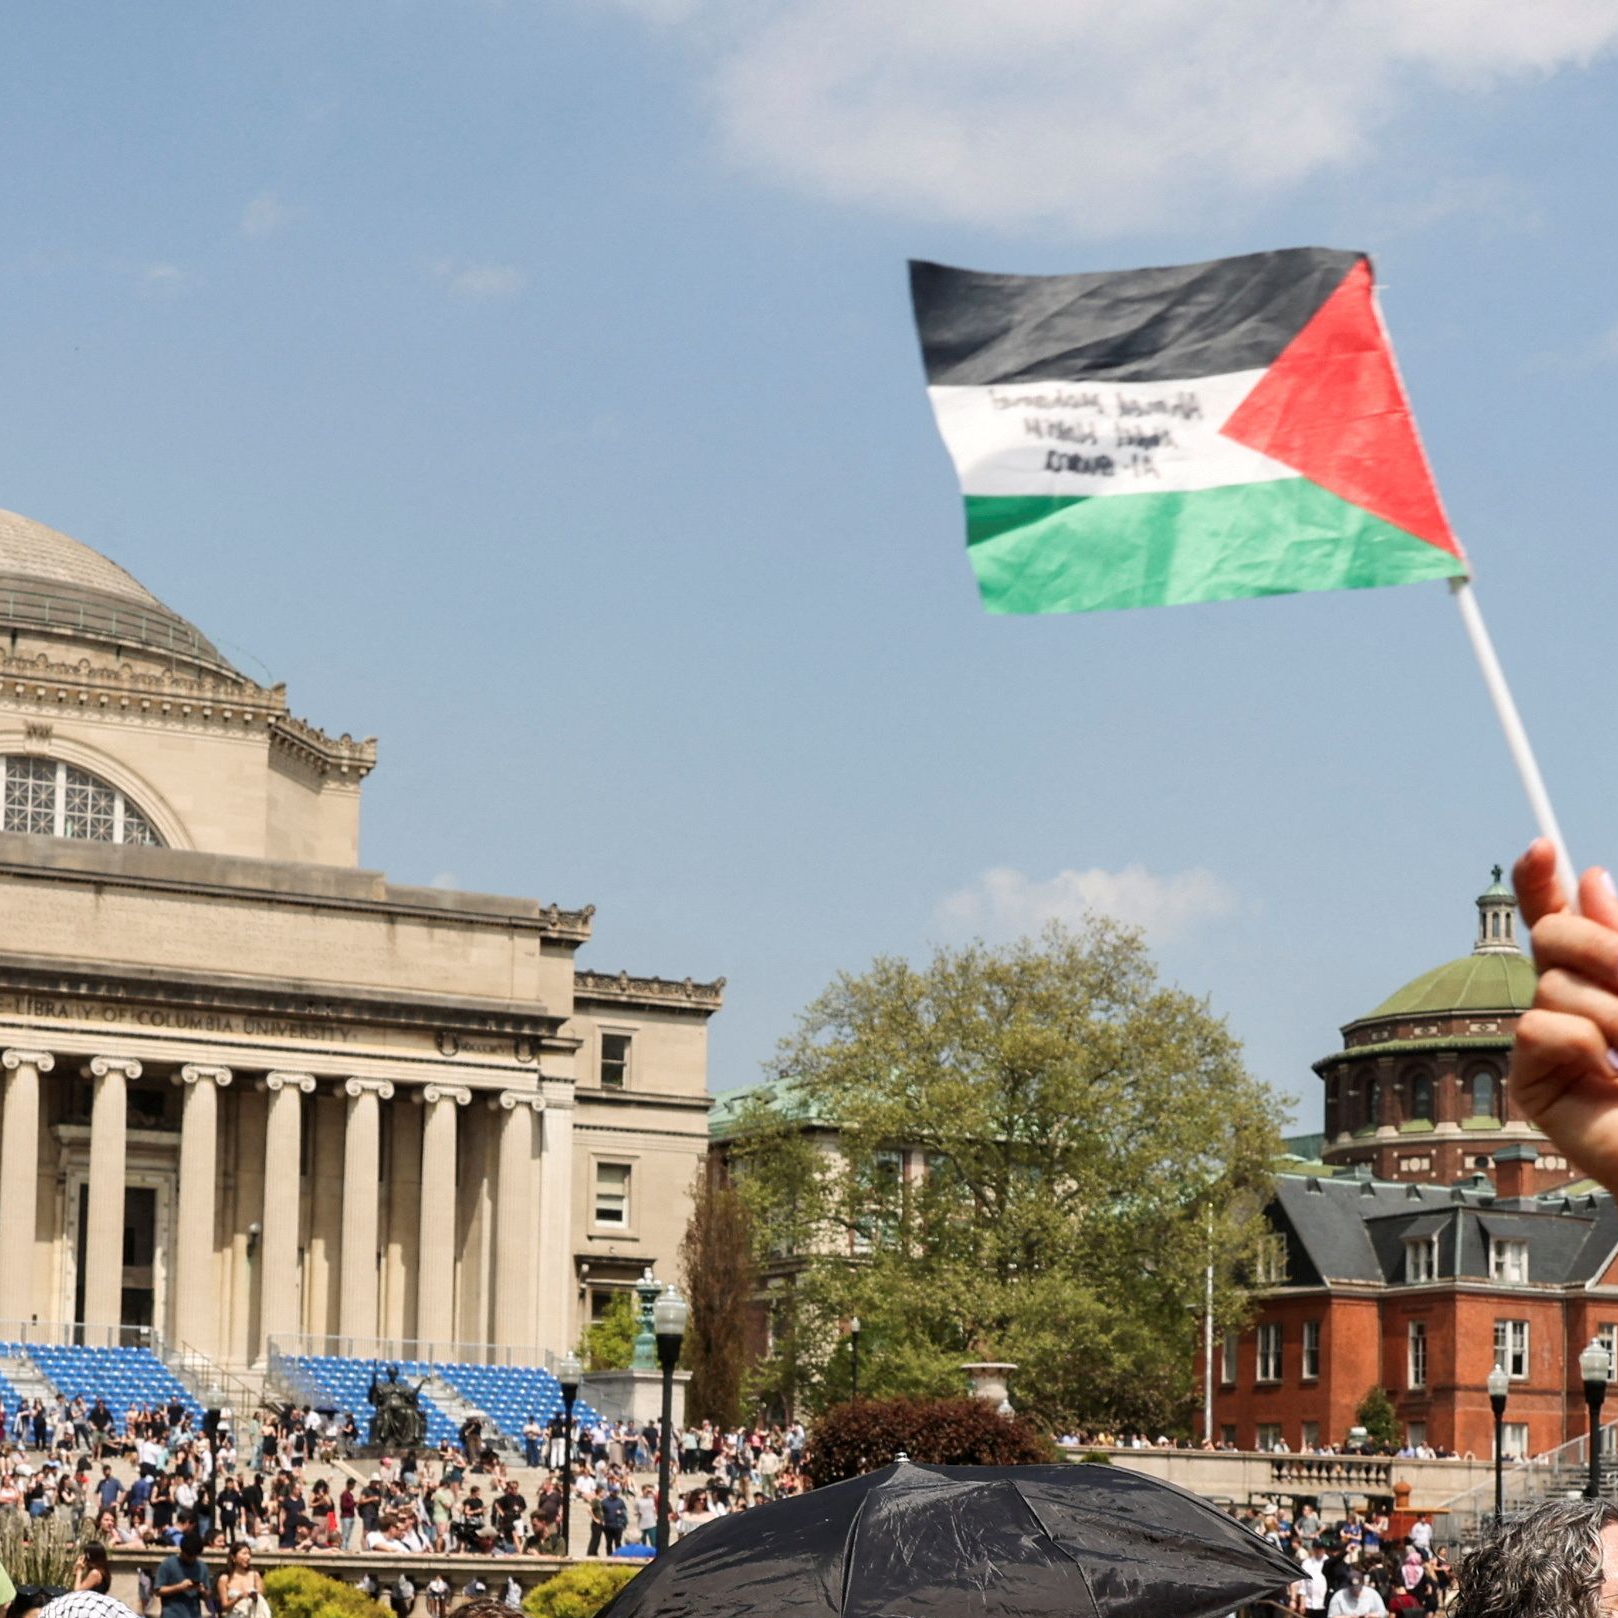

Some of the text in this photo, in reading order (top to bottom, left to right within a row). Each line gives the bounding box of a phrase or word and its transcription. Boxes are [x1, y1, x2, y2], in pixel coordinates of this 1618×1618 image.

[102, 1007, 130, 1023] OF
[137, 1010, 235, 1034] COLUMBIA
[244, 1018, 353, 1042] UNIVERSITY
